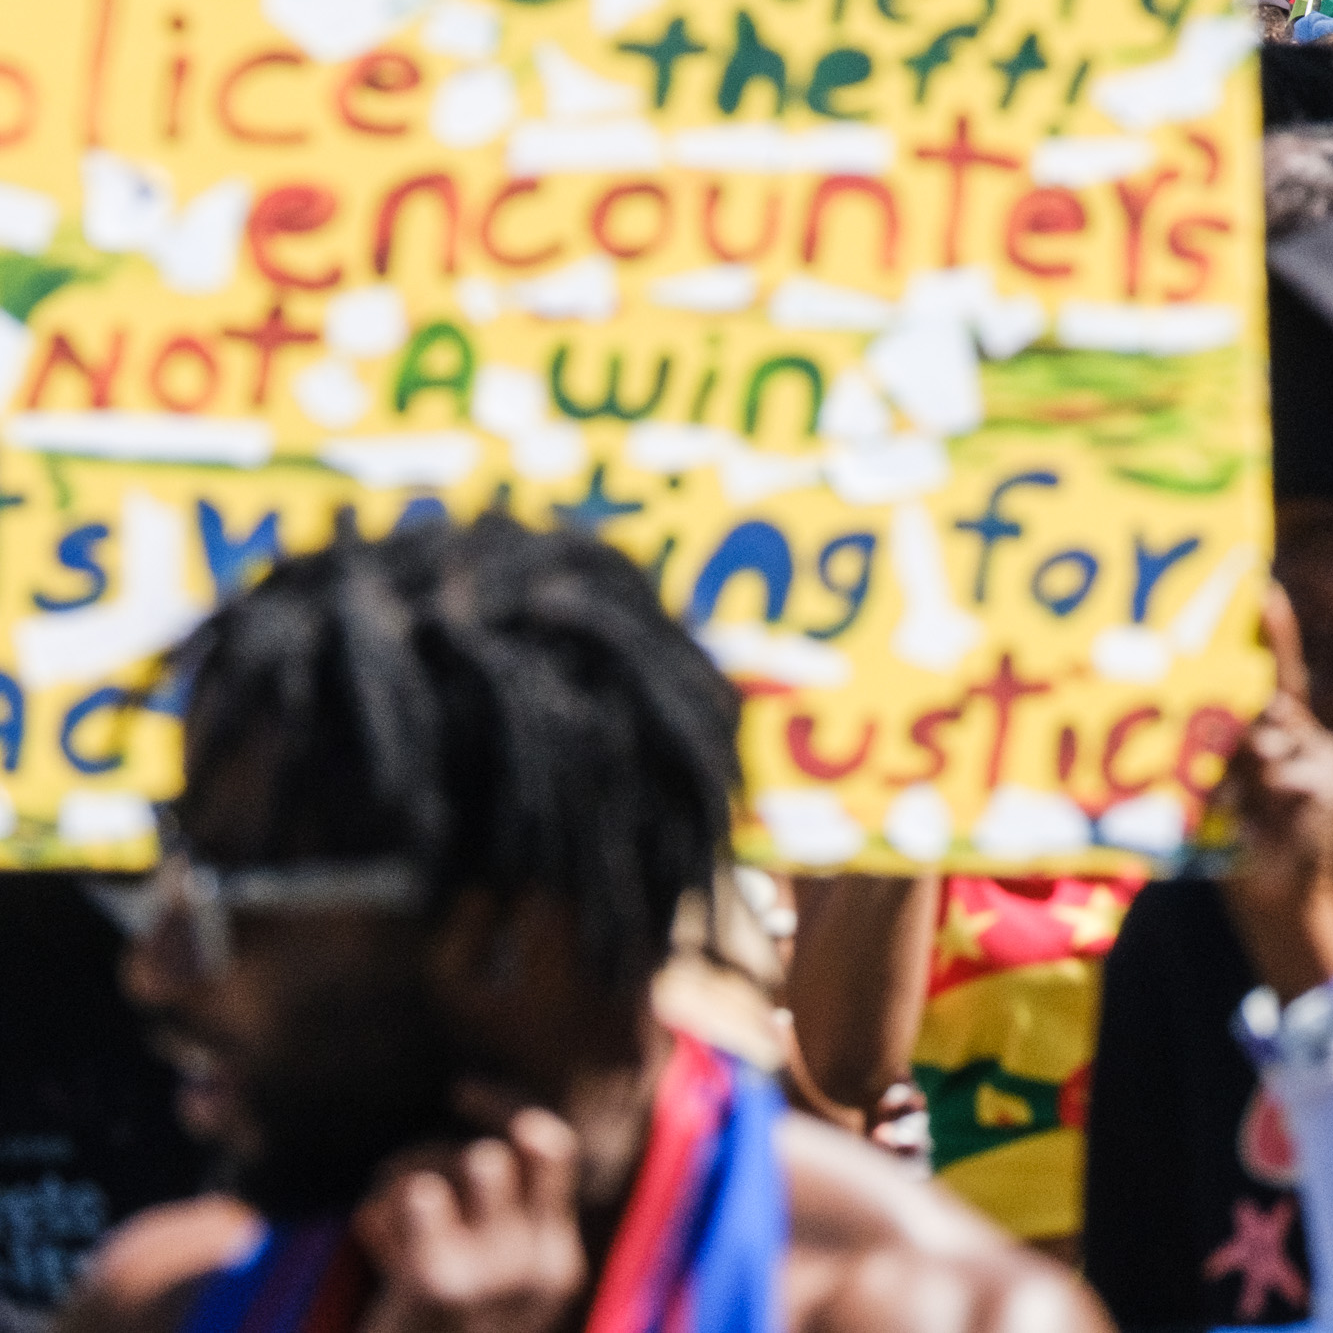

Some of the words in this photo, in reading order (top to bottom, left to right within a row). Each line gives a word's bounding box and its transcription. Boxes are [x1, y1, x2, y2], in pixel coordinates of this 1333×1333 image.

[616, 9, 1090, 138] theft!
[392, 321, 475, 415] A
[956, 471, 1200, 624] for
[736, 652, 1247, 796] ustice
